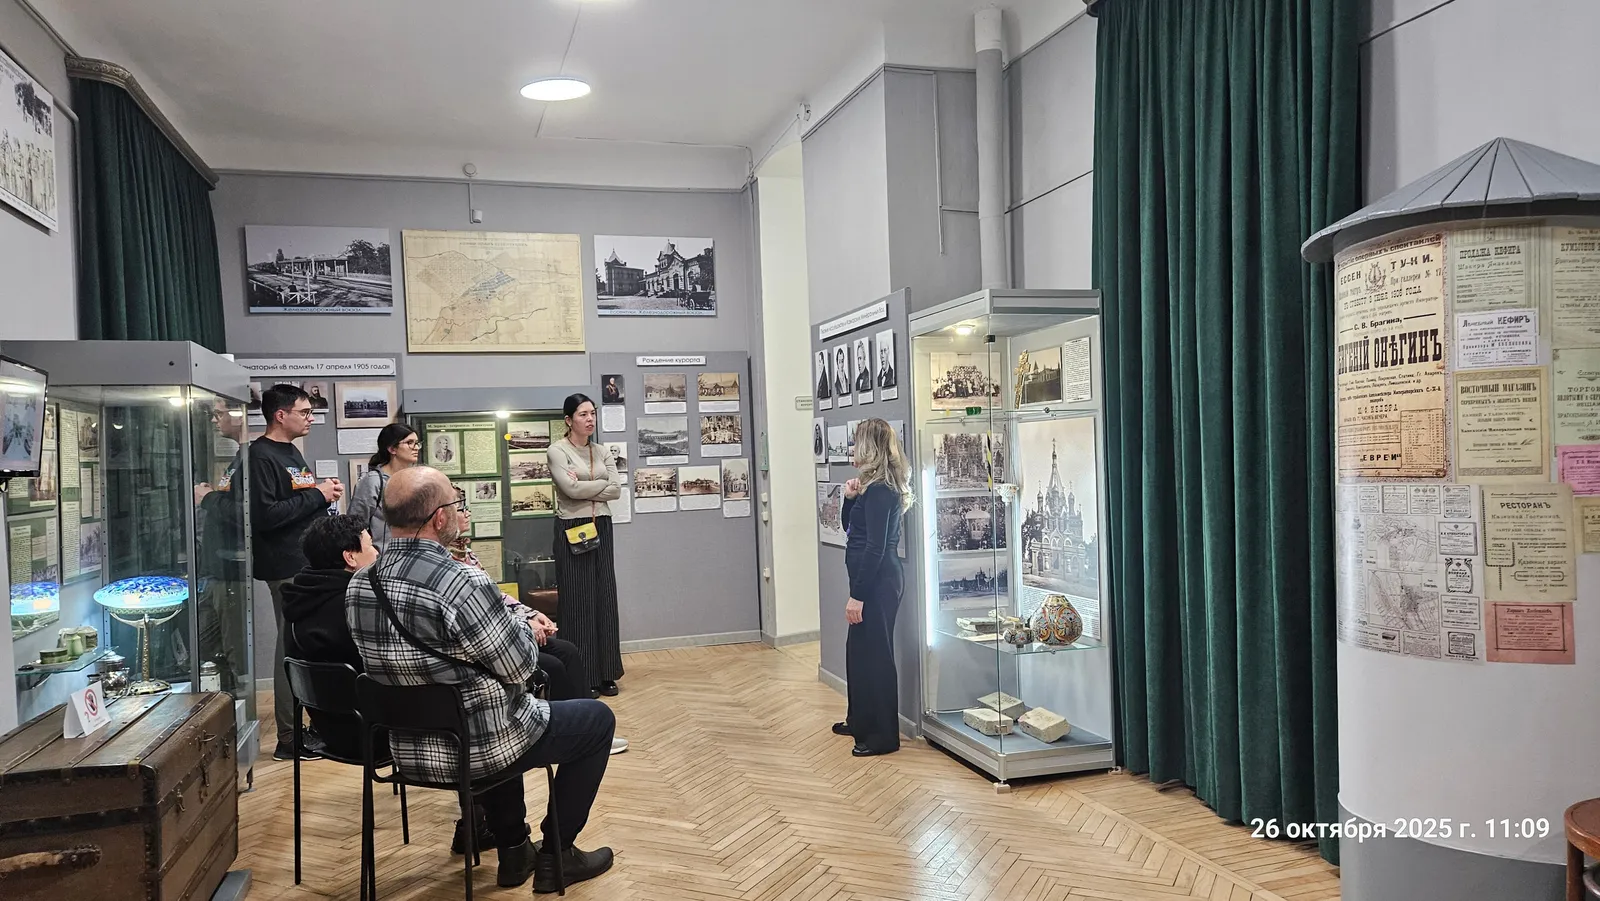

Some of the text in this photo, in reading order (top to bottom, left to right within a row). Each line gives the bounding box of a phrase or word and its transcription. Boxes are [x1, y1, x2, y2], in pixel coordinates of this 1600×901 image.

[1459, 245, 1521, 259] ПРОДАЖА КЕФИРА
[1361, 321, 1368, 329] В.
[1370, 317, 1403, 328] Брагина,
[1497, 315, 1531, 325] КЕФИРЪ
[1374, 328, 1442, 369] ОНѢГИНЪ
[1460, 382, 1537, 394] ВОСТОЧНЫЙ МАГАЗИНЪ
